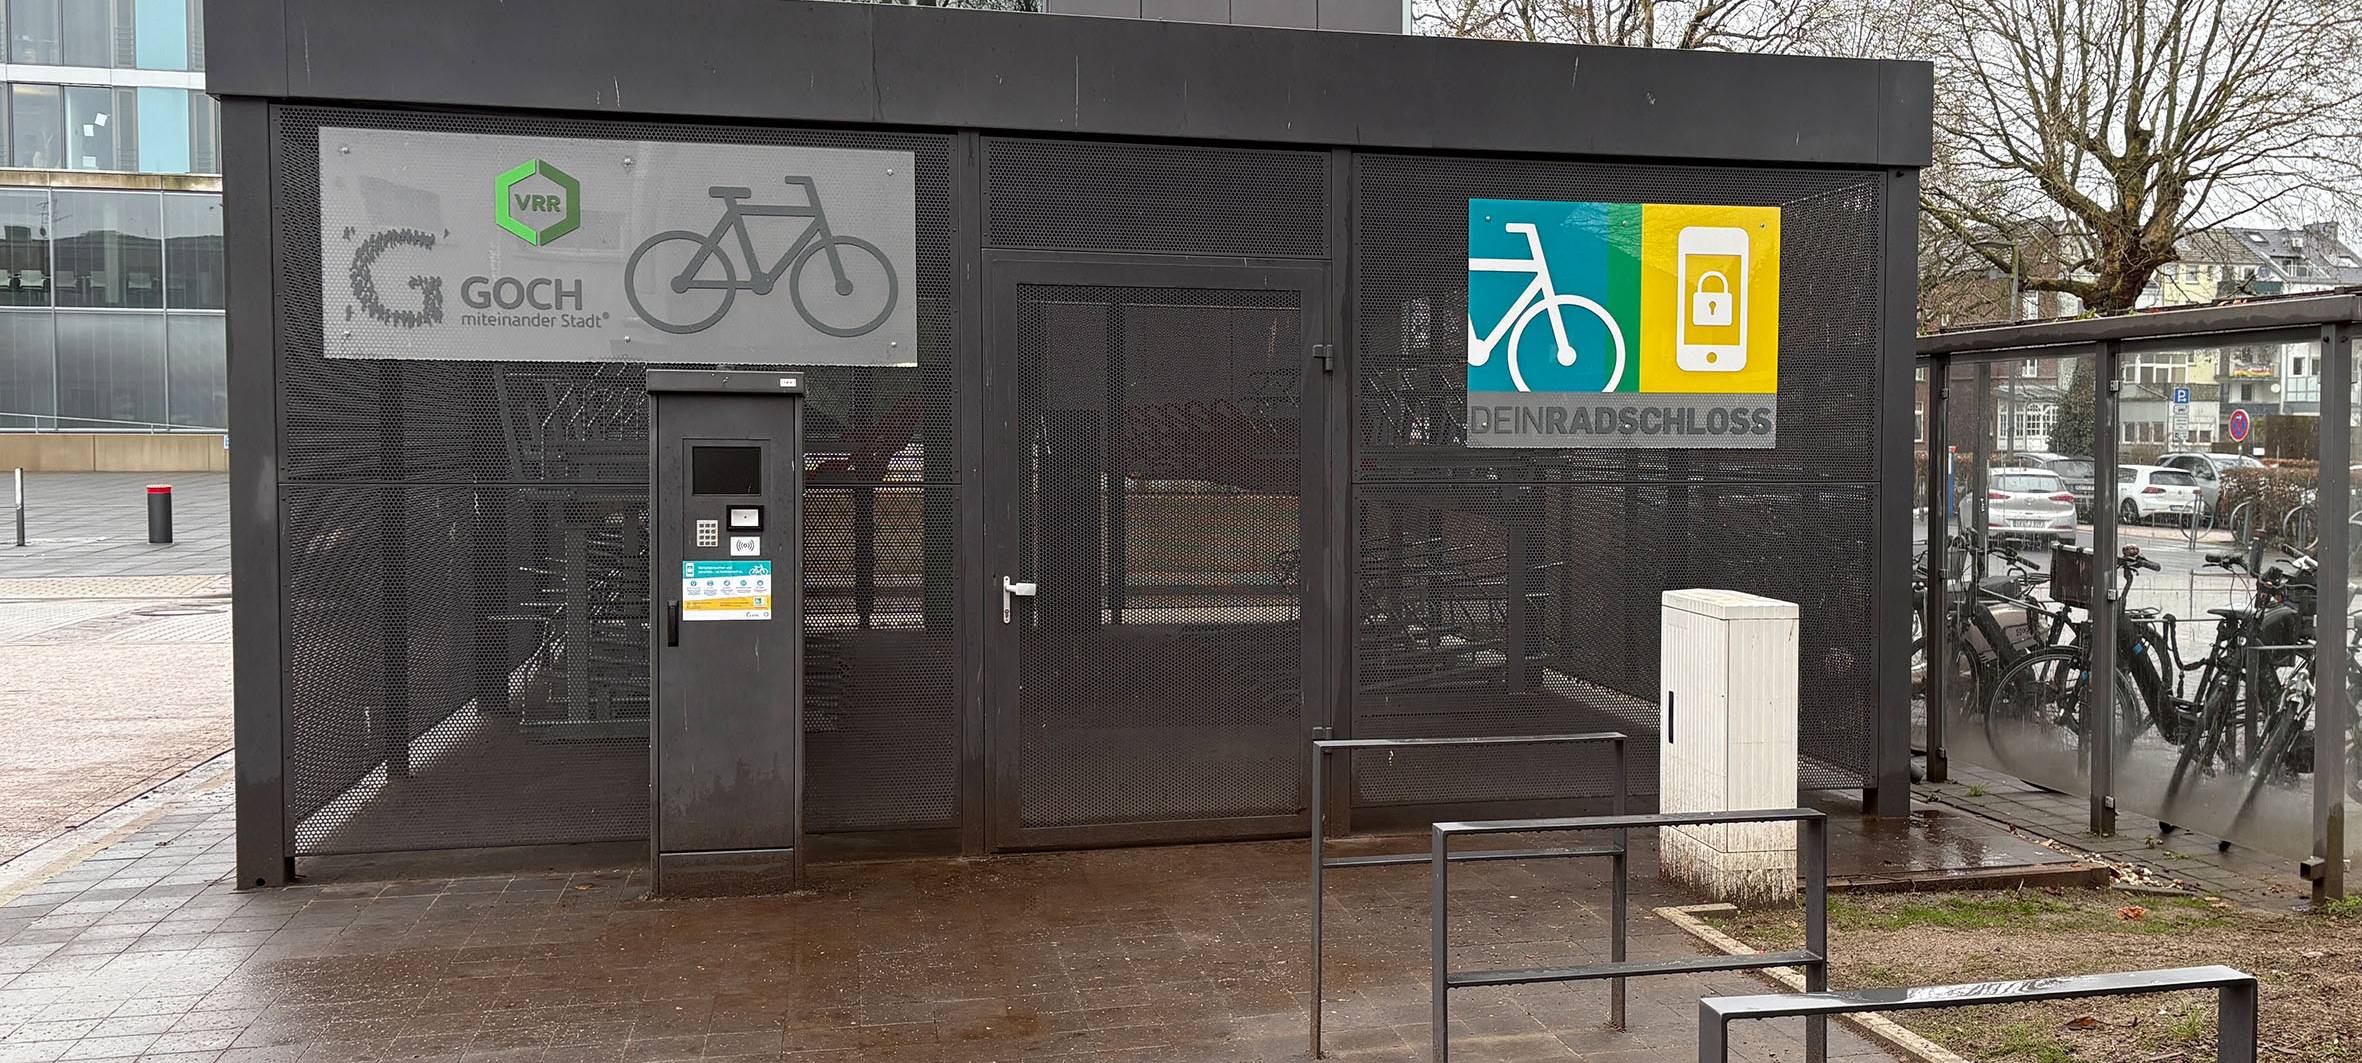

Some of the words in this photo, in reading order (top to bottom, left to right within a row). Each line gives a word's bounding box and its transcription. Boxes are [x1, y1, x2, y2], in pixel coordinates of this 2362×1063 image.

[514, 193, 561, 213] VRR
[460, 276, 583, 311] GOCH
[461, 312, 557, 328] miteinander
[1470, 405, 1773, 436] DEINRADSCHLOSS
